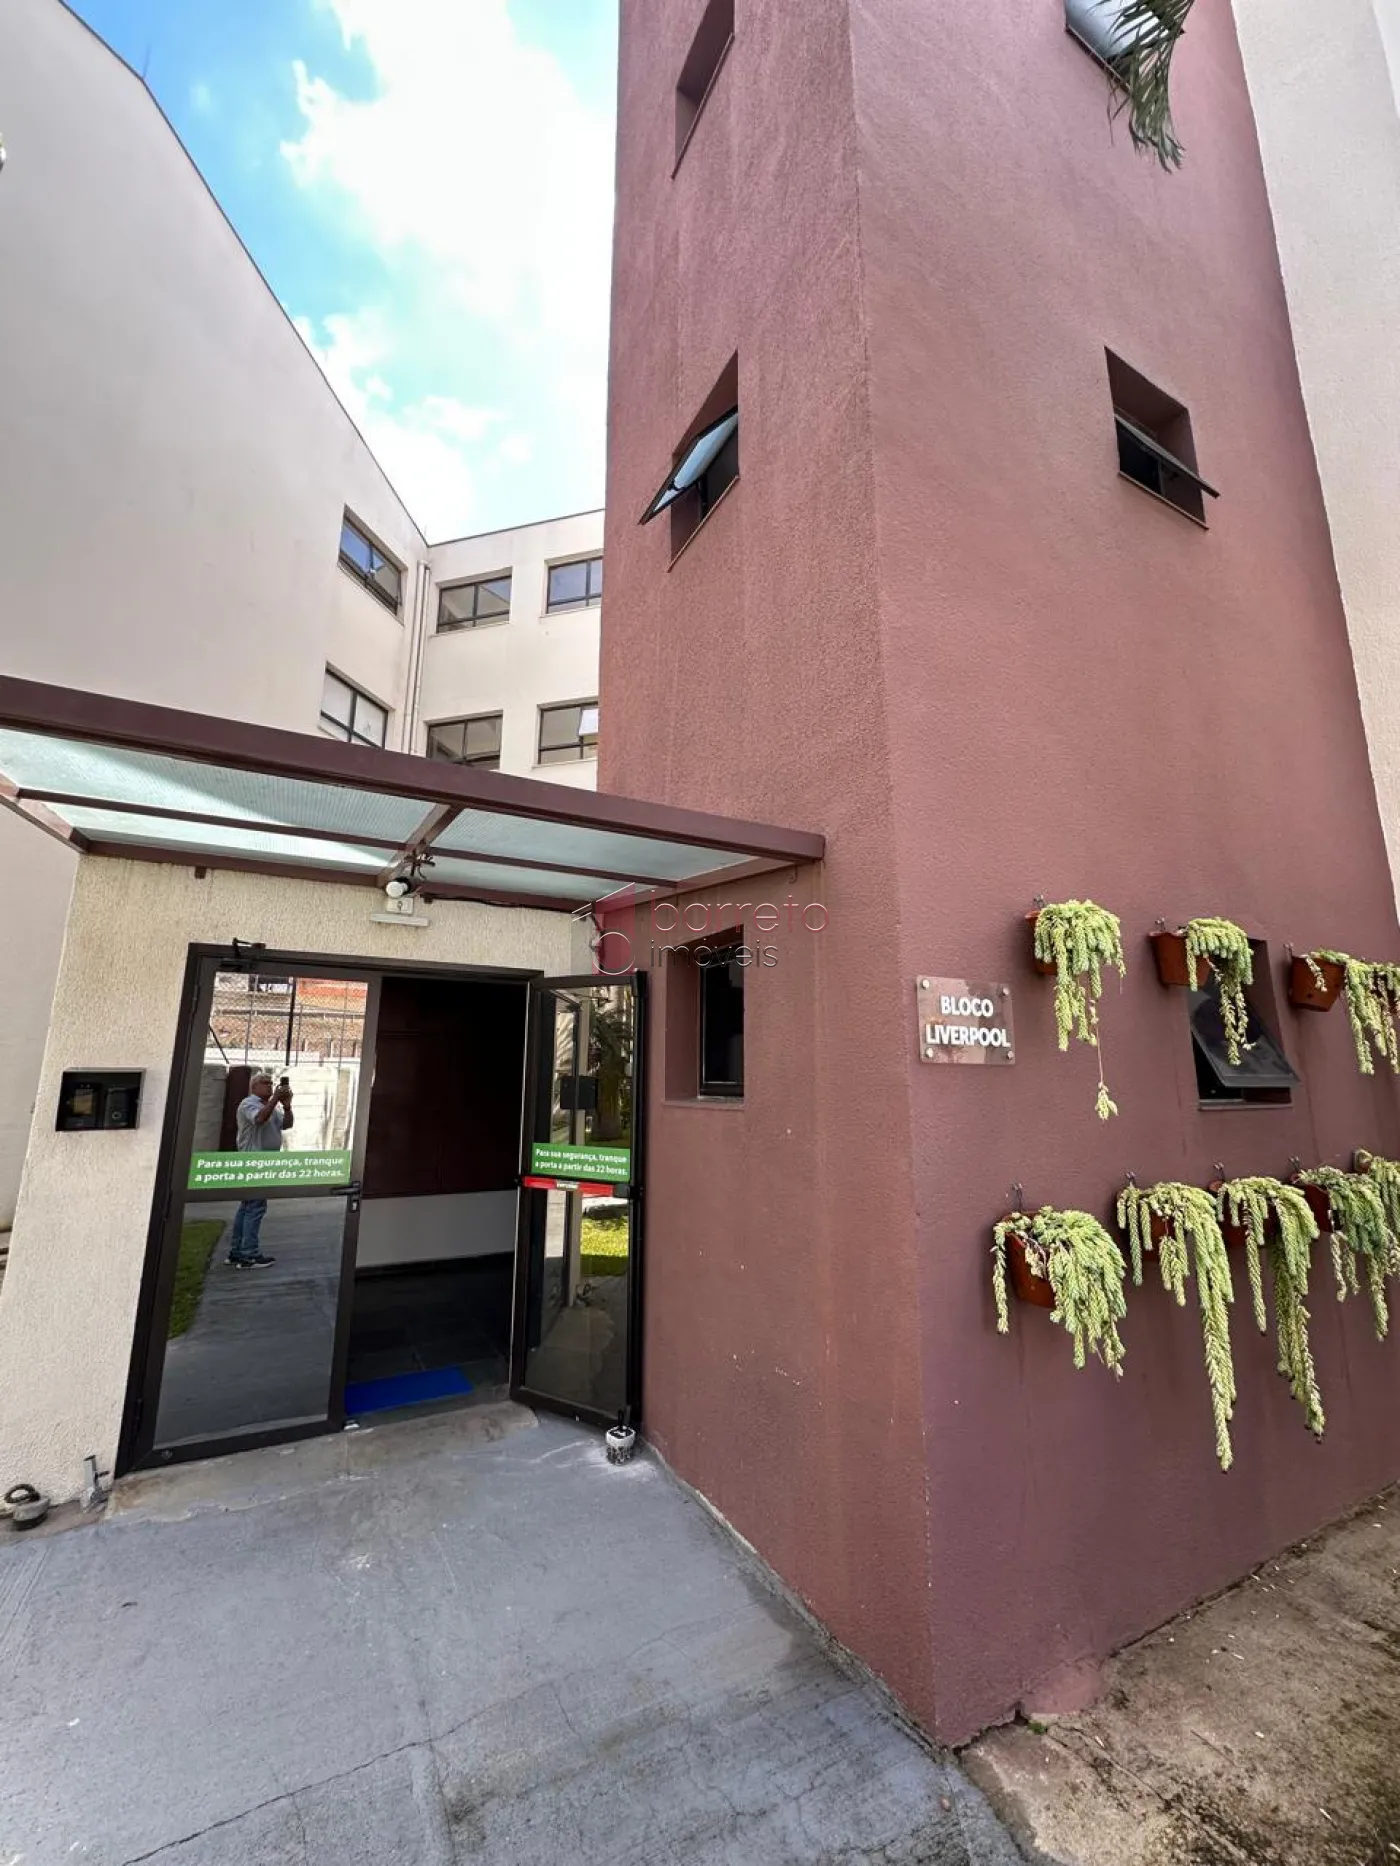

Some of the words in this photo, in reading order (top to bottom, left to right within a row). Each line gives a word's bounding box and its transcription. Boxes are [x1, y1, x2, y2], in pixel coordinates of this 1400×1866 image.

[940, 996, 994, 1017] BLOCO
[925, 1024, 1011, 1048] LIVERPOOL
[197, 1159, 222, 1168] Para
[245, 1159, 302, 1169] segurança,
[305, 1157, 344, 1167] tranque
[536, 1148, 549, 1157] Para
[599, 1154, 627, 1164] tranque
[540, 1161, 558, 1170] porta
[562, 1162, 582, 1172] partir
[582, 1163, 595, 1172] das
[595, 1164, 605, 1173] 22
[195, 1174, 202, 1182] a
[203, 1172, 235, 1183] porta
[237, 1172, 244, 1180] a
[245, 1170, 277, 1182] partir
[278, 1169, 297, 1179] das
[298, 1169, 312, 1178] 22
[313, 1168, 345, 1177] horas.
